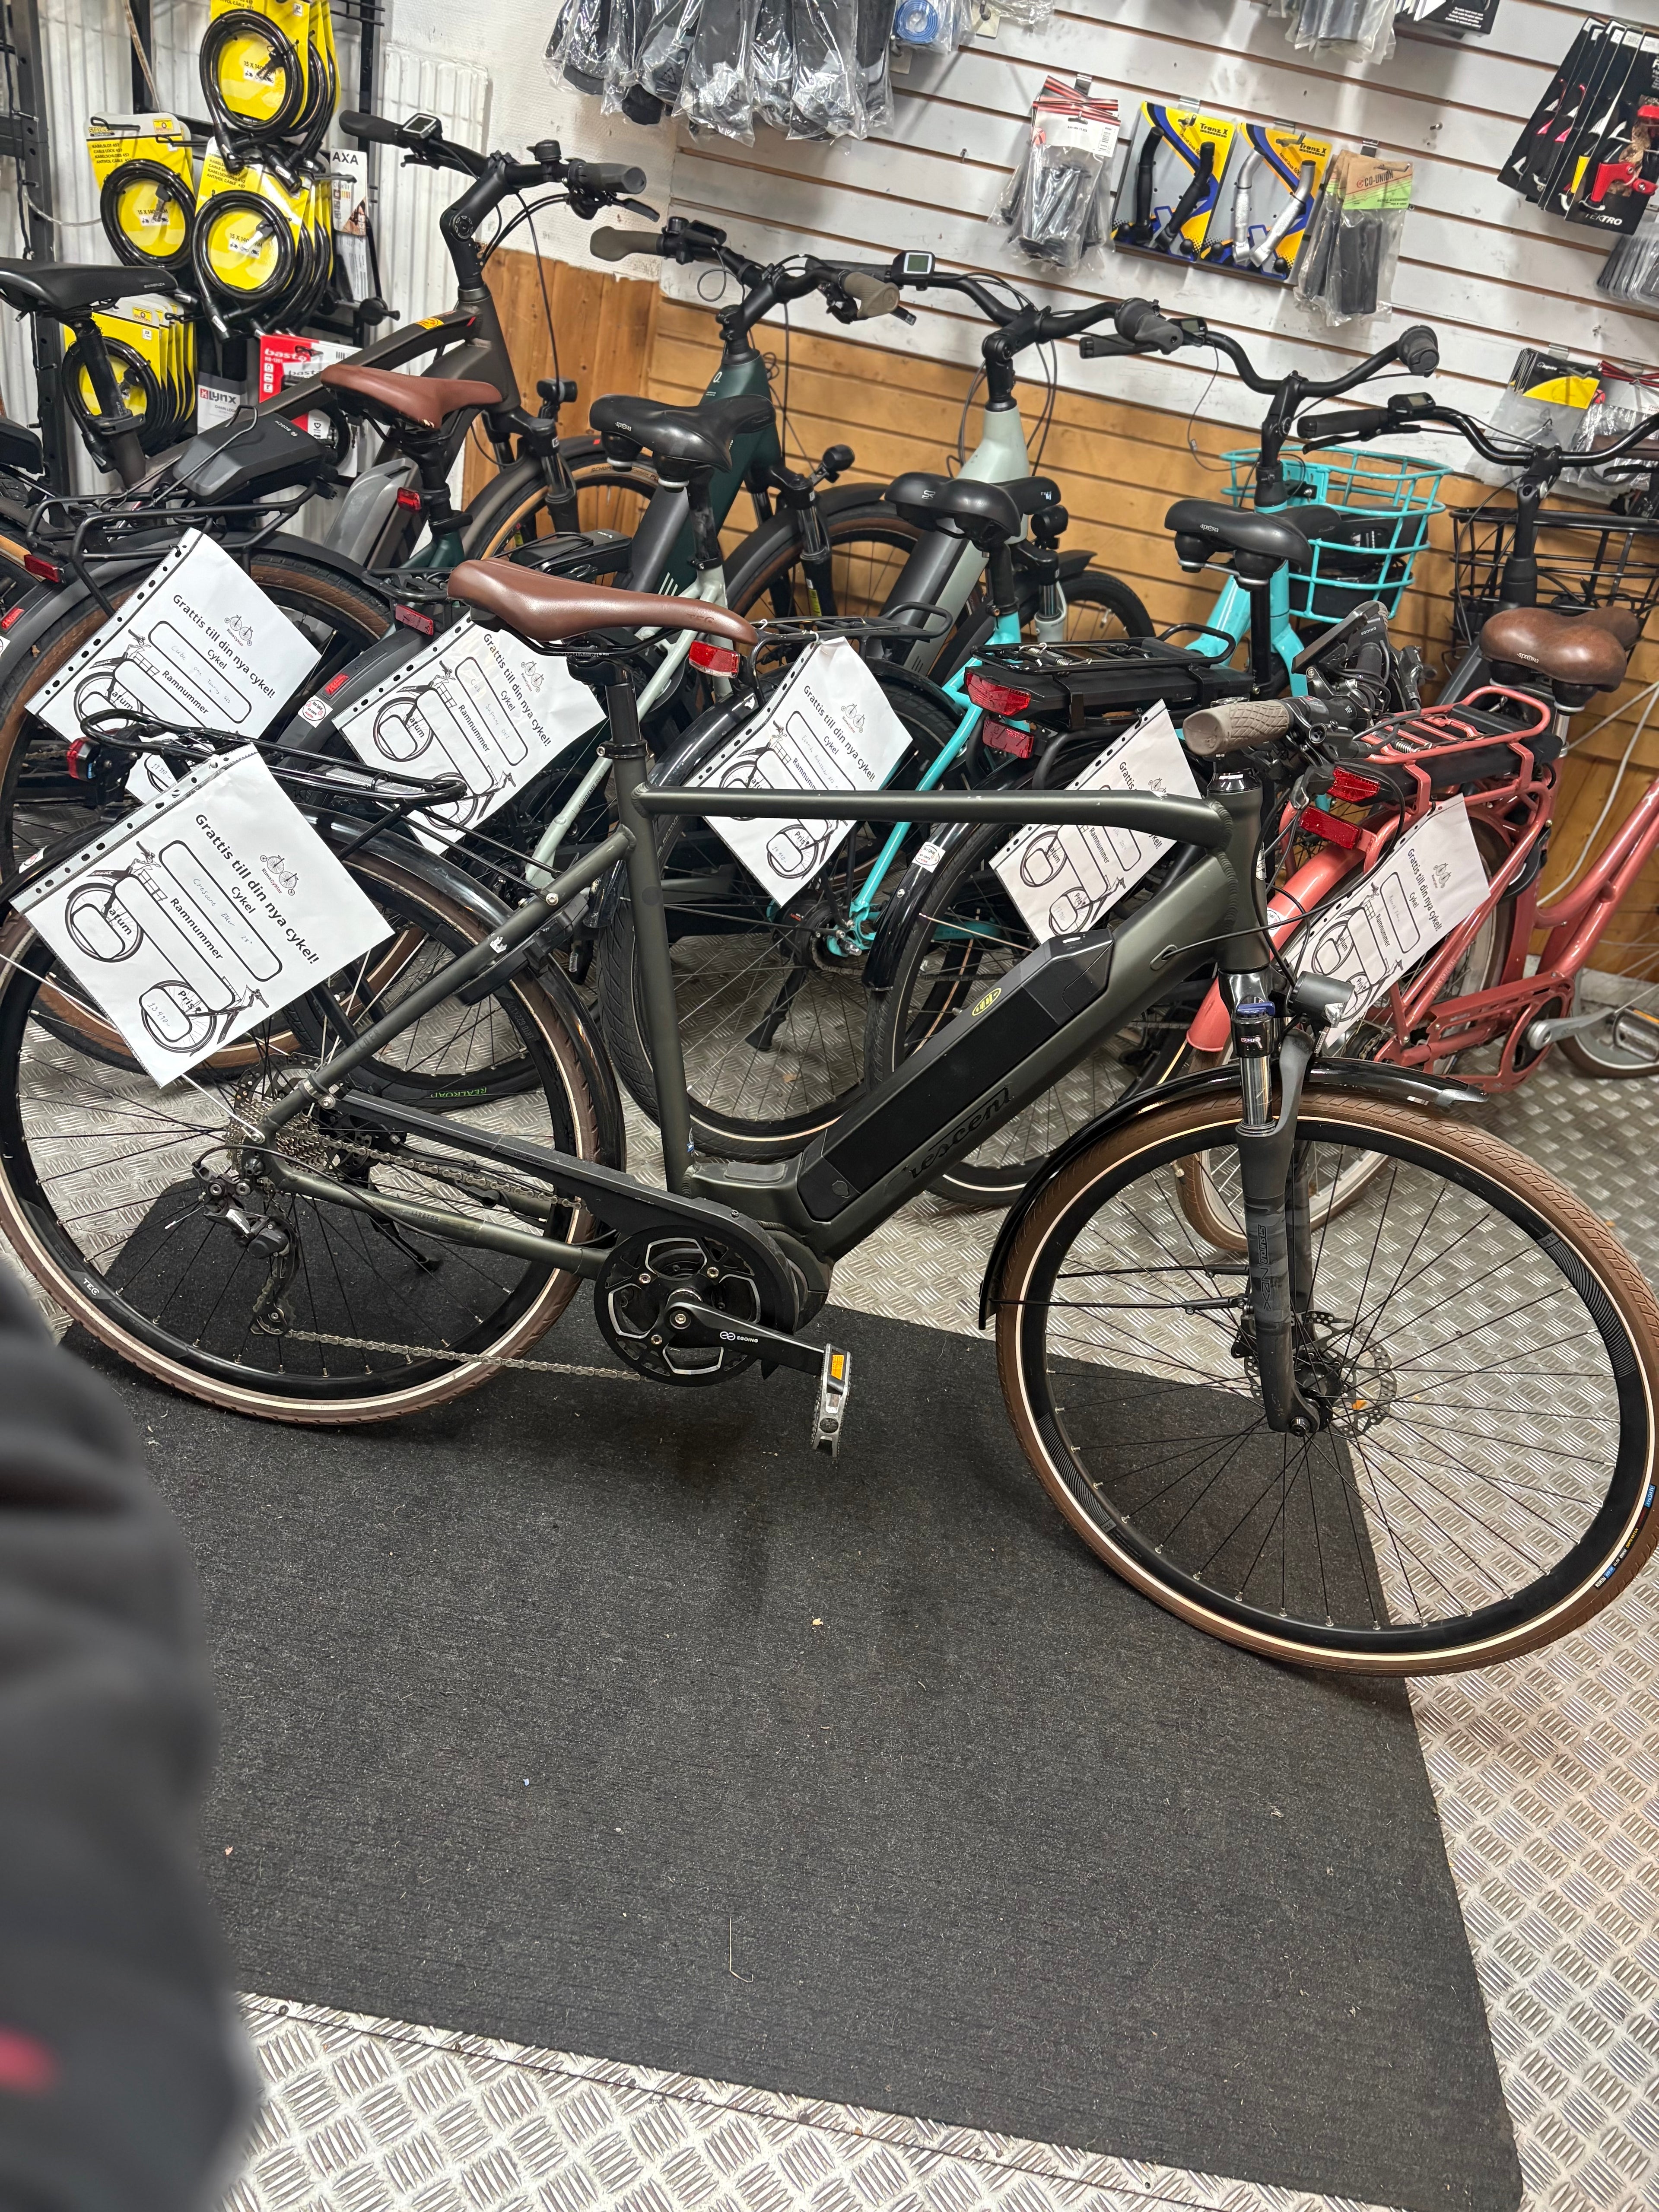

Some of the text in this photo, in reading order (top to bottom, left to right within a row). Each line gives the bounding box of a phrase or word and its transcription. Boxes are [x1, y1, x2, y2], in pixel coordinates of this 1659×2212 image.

[1200, 123, 1221, 133] Tranz
[332, 151, 359, 166] AXA
[1300, 143, 1321, 153] Tranz
[1364, 170, 1394, 187] CO-UNION
[1585, 213, 1623, 226] TEKTRO
[264, 348, 307, 362] basta
[209, 391, 237, 404] Lynx
[274, 420, 292, 432] BOSCH
[1360, 628, 1377, 636] EGOING
[173, 594, 276, 699] Grattis till din nya cykel!
[207, 649, 228, 669] Cykel
[108, 687, 133, 711] atum
[162, 670, 209, 714] Ramnummer
[483, 633, 552, 747] Grattis till din nya cykel!
[501, 690, 516, 712] Cykel
[408, 715, 426, 739] atum
[458, 705, 490, 753] Ramnummer
[804, 685, 876, 783] Grattis till din nya cykel!
[824, 736, 840, 756] Cykel
[1119, 762, 1134, 790] Grattis
[578, 786, 596, 809] SUPREME
[1049, 846, 1061, 864] atum
[1089, 827, 1110, 864] Ramnummer
[196, 814, 320, 964] Grattis till din nya cykel!
[262, 868, 283, 894] RimaCyklar
[1408, 849, 1443, 932] Grattis till din nya cykel!
[231, 886, 257, 914] Cykel
[1409, 892, 1420, 909] Cykel
[107, 906, 132, 936] atum
[170, 898, 223, 960] Ramnummer
[1375, 913, 1390, 947] Ramnummer
[1338, 935, 1348, 952] atum
[178, 990, 195, 1010] Pris
[354, 1029, 381, 1053] ELDER
[431, 1087, 488, 1098] REALROAD
[84, 1278, 100, 1296] TEC
[1260, 1267, 1271, 1310] NEX
[736, 1335, 759, 1343] EGOING
